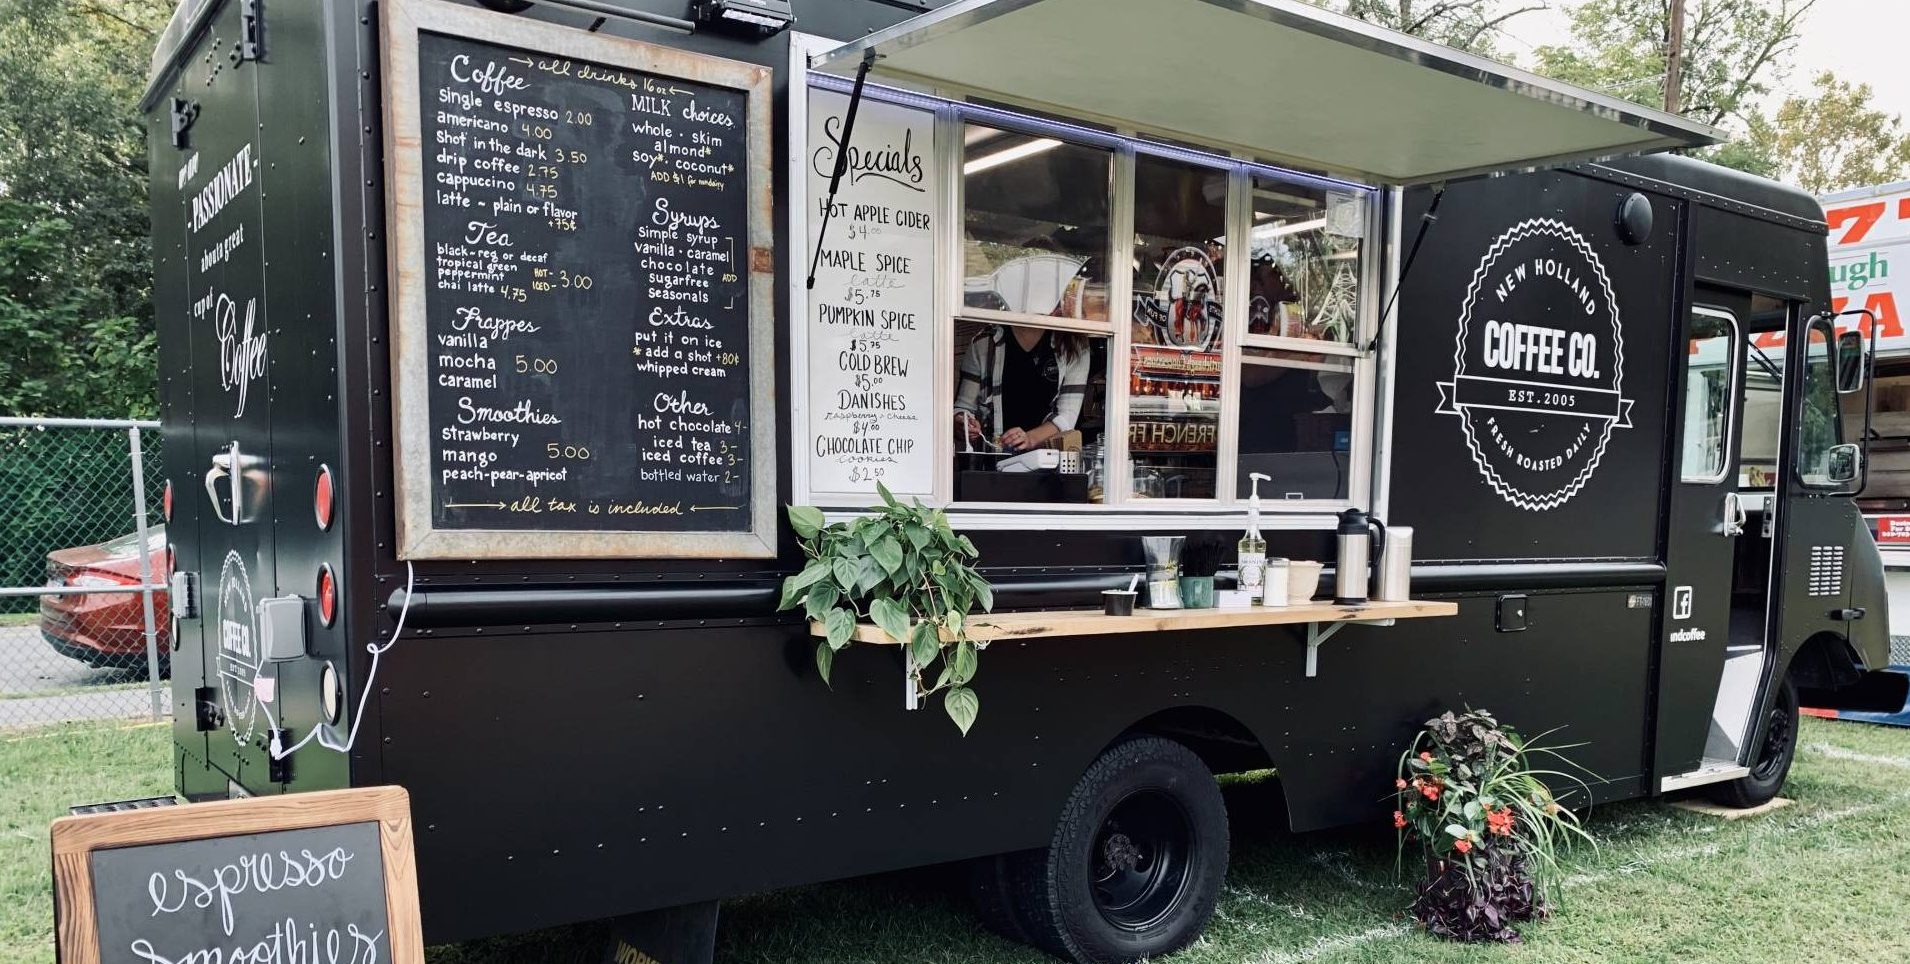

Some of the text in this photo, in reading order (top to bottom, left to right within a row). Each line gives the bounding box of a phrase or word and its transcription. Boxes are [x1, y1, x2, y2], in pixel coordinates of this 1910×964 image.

[451, 55, 531, 95] Coffee
[539, 60, 570, 75] all
[578, 65, 637, 89] drinks
[644, 78, 654, 92] 16
[439, 87, 592, 125] single espresso 2.00
[632, 94, 671, 117] MILK
[437, 111, 552, 139] americano 4.00
[632, 122, 722, 147] whole skim
[474, 137, 485, 149] in
[489, 138, 511, 154] the
[516, 142, 547, 160] dark
[555, 149, 587, 163] 3.50
[813, 116, 923, 185] Specials
[437, 148, 559, 179] drip coffee 2.75
[193, 143, 252, 233] PASSIONATE
[437, 171, 558, 198] cappuccino 4.75
[651, 171, 669, 182] ADD
[673, 172, 684, 184] $1
[437, 190, 577, 219] latte plain or flavor
[652, 198, 720, 235] Syrups
[819, 197, 930, 230] HOT APPLE CIDER
[225, 223, 243, 262] great
[465, 221, 513, 246] Tea
[687, 233, 717, 250] syrup
[436, 256, 517, 273] tropical green
[520, 251, 548, 263] decaf
[641, 257, 714, 275] chocolate
[687, 249, 729, 262] caramel
[821, 249, 911, 273] MAPLE SPICE
[438, 268, 504, 280] peppermint
[560, 270, 592, 290] 3.00
[649, 273, 737, 289] sugarfree ADD
[1830, 252, 1888, 290] ugh
[438, 280, 527, 302] chai latte 4.75
[1496, 258, 1595, 315] NEW HOLLAND
[452, 307, 541, 340] Frappes
[649, 305, 714, 329] Extras
[820, 304, 915, 330] PUMPKIN SPICE
[438, 333, 487, 348] vanilla
[635, 331, 722, 348] put it on ice
[1484, 320, 1600, 379] COFFEE CO.
[216, 293, 267, 418] Coffee
[439, 353, 557, 374] mocha 5.00
[646, 346, 668, 358] add
[675, 350, 682, 359] a
[688, 350, 712, 362] shot
[839, 351, 908, 377] COLD BREW
[439, 374, 496, 388] caramel
[637, 360, 726, 378] whipped cream
[458, 397, 561, 424] Smoothies
[654, 390, 714, 415] Other
[838, 389, 905, 410] DANISHES
[638, 414, 661, 429] hot
[670, 416, 731, 433] chocolate
[442, 425, 519, 447] strawberry
[654, 435, 682, 448] iced
[691, 437, 711, 451] tea
[817, 435, 913, 457] CHOCOLATE CHIP
[1487, 416, 1591, 472] FRESH ROASTED DAILY
[443, 443, 590, 467] mango 5.00
[642, 448, 670, 463] iced
[680, 452, 722, 465] coffee
[641, 468, 681, 482] bottled
[687, 470, 719, 482] water
[511, 495, 683, 515] all tax is included
[149, 847, 353, 936] espresso
